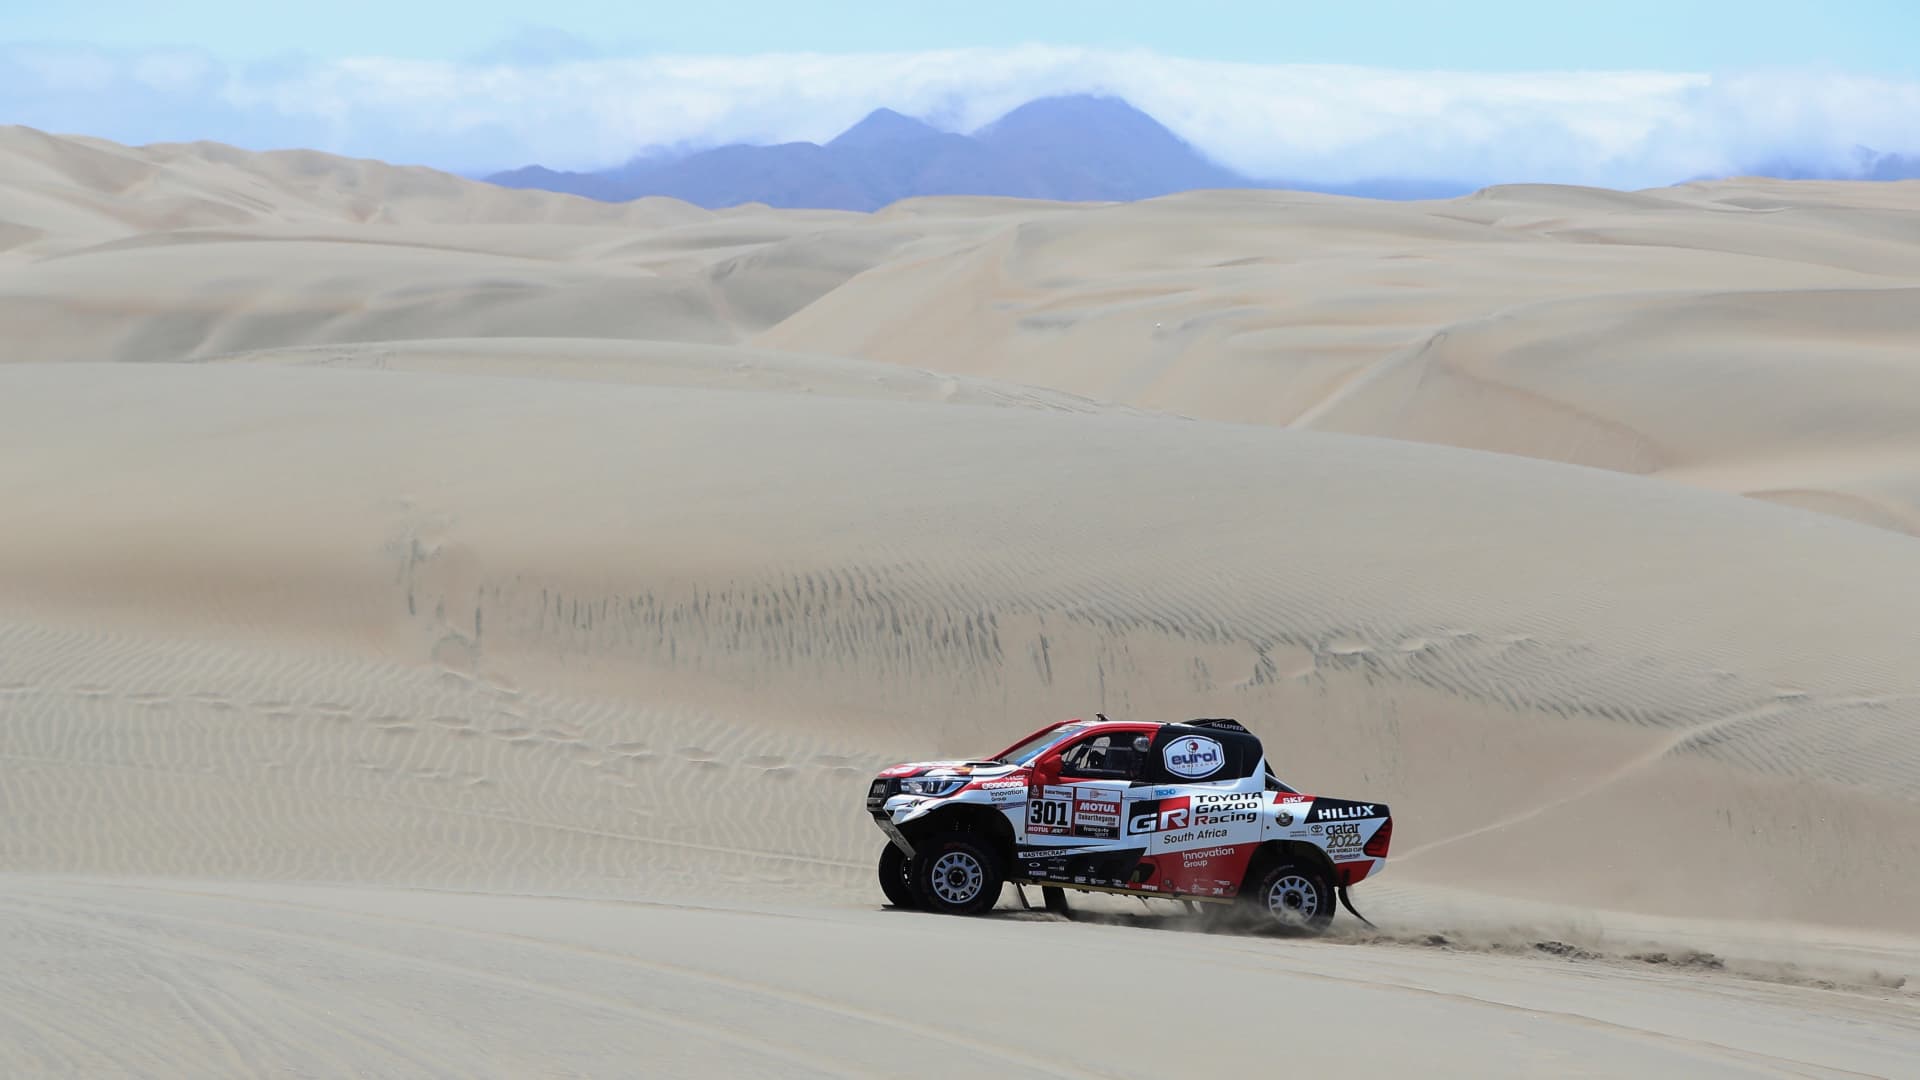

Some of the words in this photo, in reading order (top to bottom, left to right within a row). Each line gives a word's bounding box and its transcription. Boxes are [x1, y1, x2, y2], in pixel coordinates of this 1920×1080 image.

[1171, 749, 1218, 766] eurol
[990, 789, 1025, 797] Innovation
[1195, 791, 1264, 804] TOYOTA
[1282, 795, 1305, 804] SKF
[1030, 800, 1068, 826] 301
[1080, 802, 1116, 813] MOTUL
[1195, 802, 1258, 815] GAZOO
[1317, 804, 1375, 820] HILUX
[1128, 808, 1189, 834] GR
[1194, 812, 1258, 827] Racing
[1163, 831, 1195, 845] South
[1196, 829, 1228, 841] Africa
[1325, 822, 1361, 838] qatar
[1326, 834, 1363, 849] 2022
[1182, 847, 1235, 860] Innovation
[1183, 859, 1208, 869] Group
